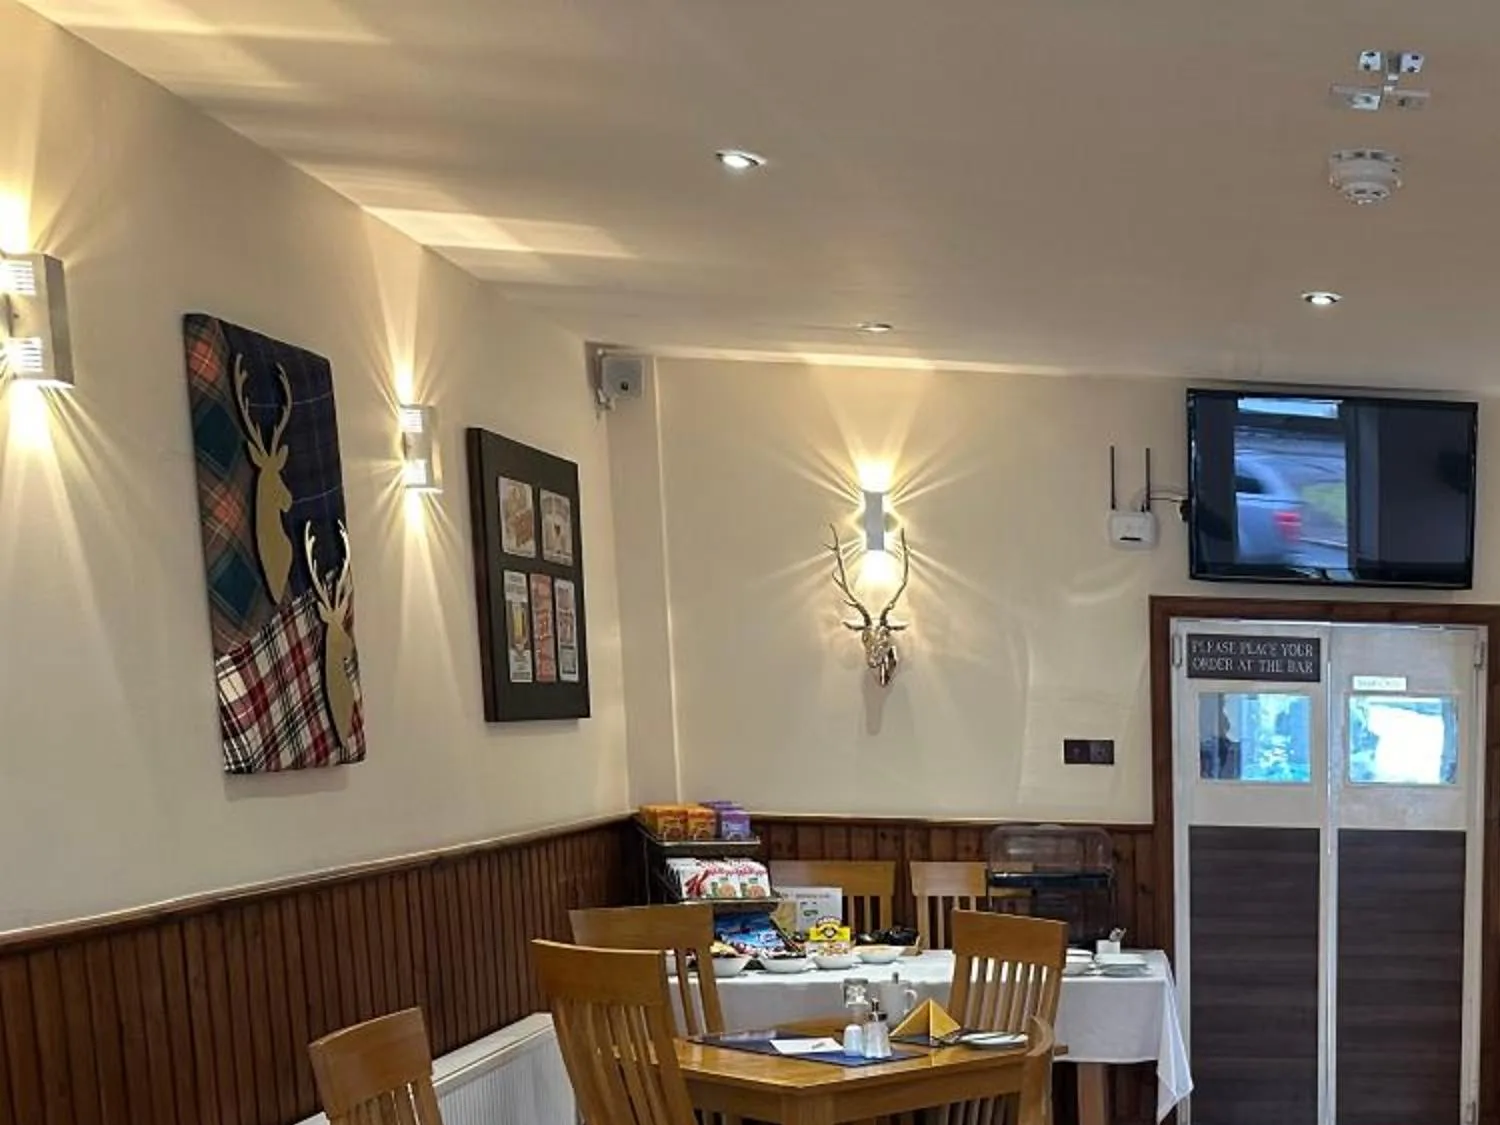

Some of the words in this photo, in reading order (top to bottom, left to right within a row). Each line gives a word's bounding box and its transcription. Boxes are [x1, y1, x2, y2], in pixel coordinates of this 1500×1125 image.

[1192, 641, 1236, 655] PLEASE
[1240, 641, 1277, 656] PLACE
[1281, 643, 1313, 657] YOUR
[1192, 657, 1233, 671] ORDER
[1238, 658, 1255, 671] AT
[1260, 659, 1283, 673] THE
[1287, 660, 1313, 673] BAR
